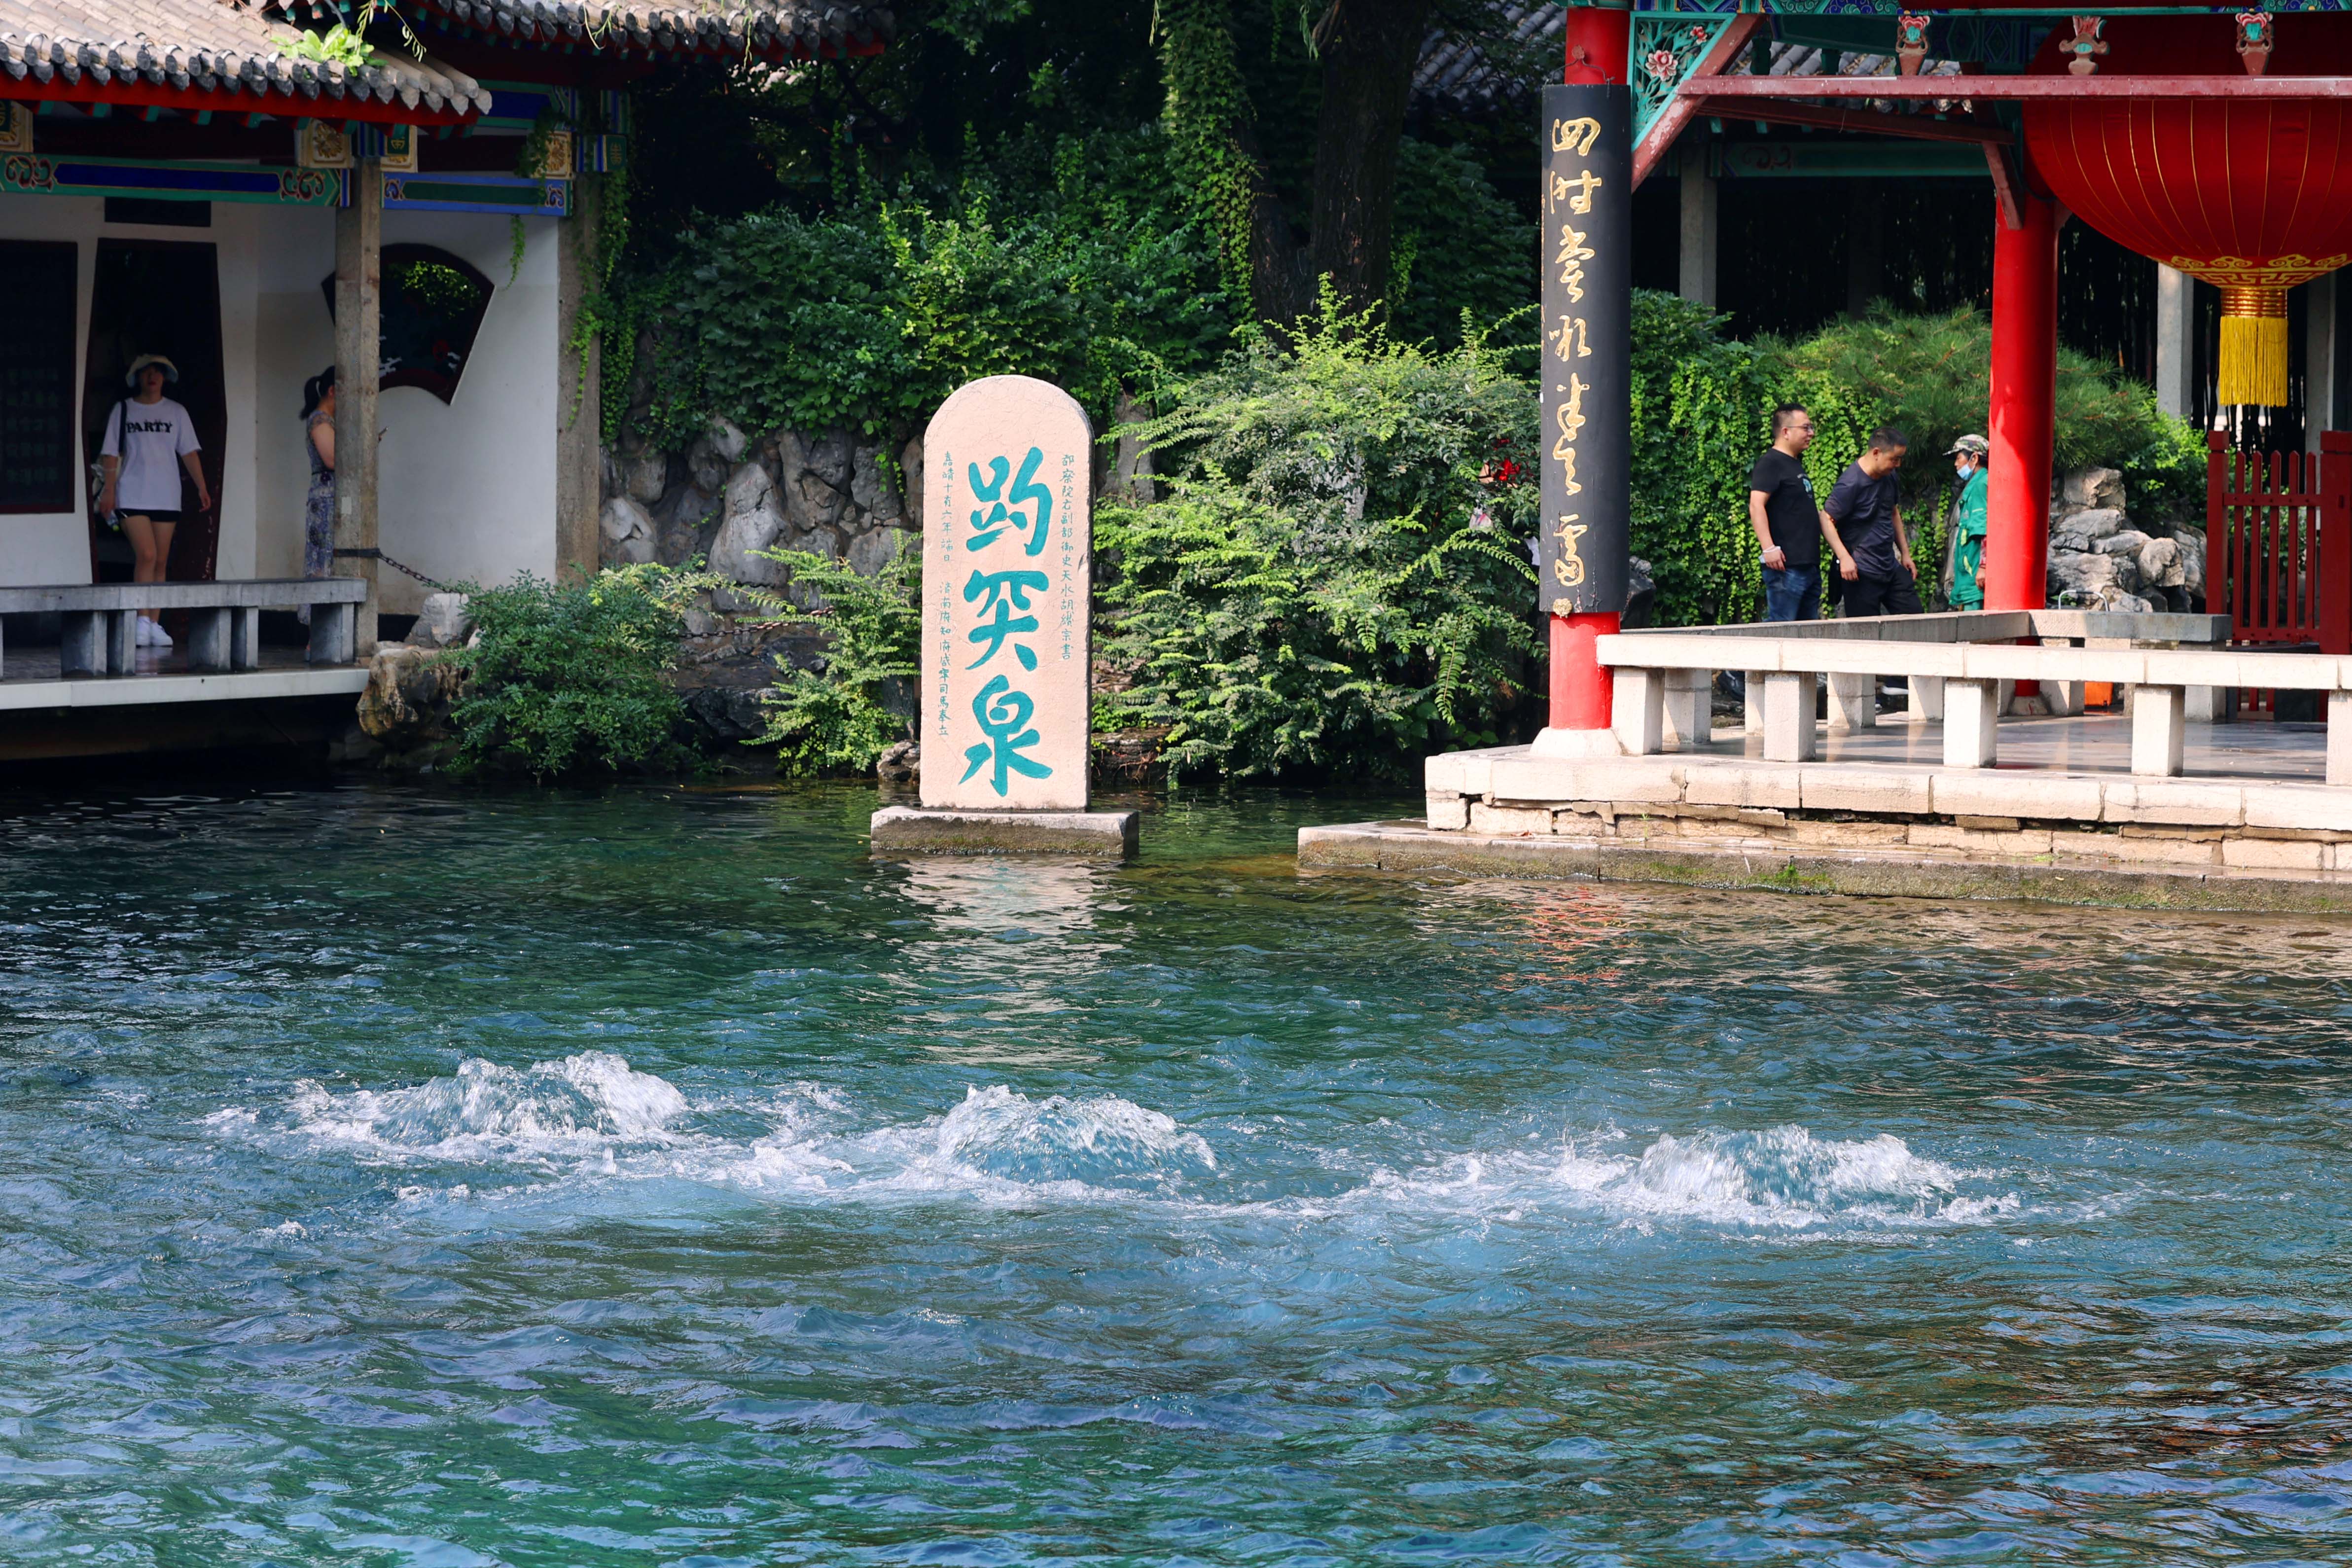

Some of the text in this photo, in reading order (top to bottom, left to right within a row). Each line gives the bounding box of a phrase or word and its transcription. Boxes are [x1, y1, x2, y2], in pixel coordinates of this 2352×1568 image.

[126, 420, 173, 433] PARTY
[959, 446, 1053, 797] 趵突泉
